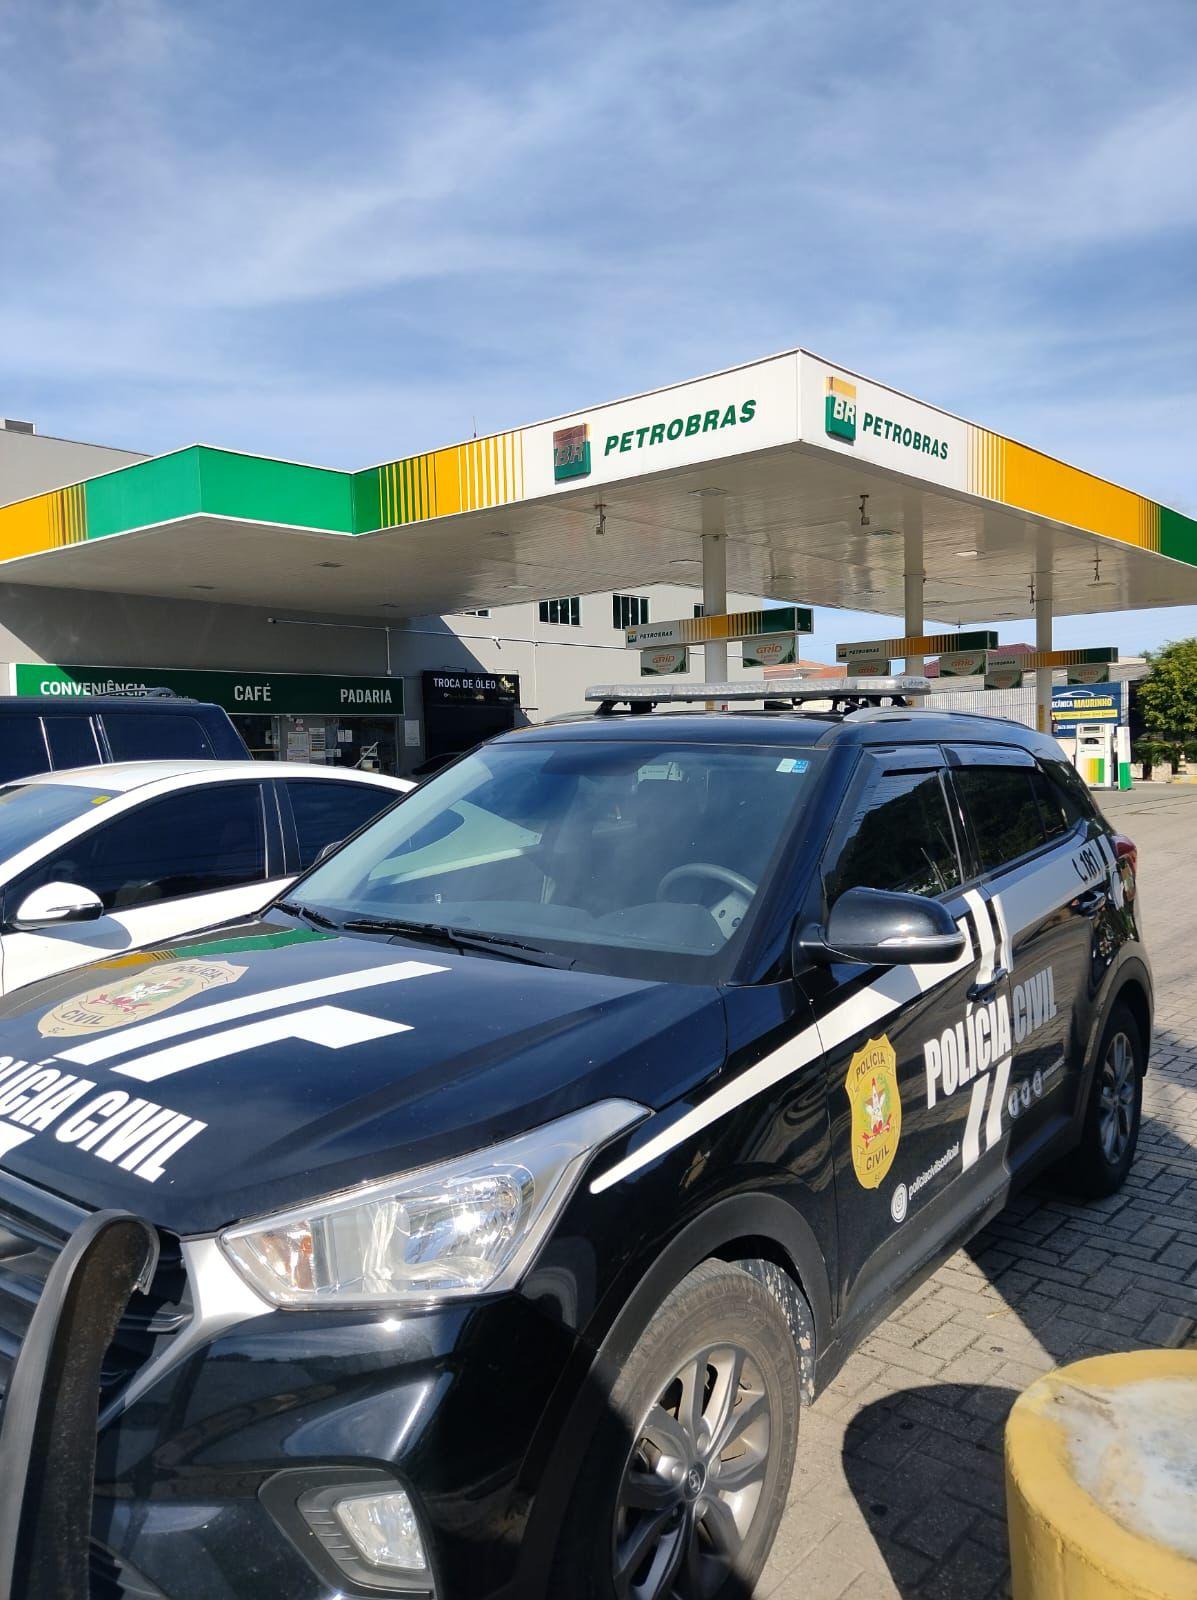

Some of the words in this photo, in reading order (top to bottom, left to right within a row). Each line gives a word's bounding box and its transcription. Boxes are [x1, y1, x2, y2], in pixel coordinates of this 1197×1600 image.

[832, 398, 856, 425] BR
[604, 399, 757, 457] PETROBRAS
[862, 412, 949, 460] PETROBRAS
[234, 682, 272, 702] CAFÉ
[340, 688, 393, 704] PADARIA
[433, 677, 461, 689] TROCA
[462, 679, 474, 689] DE
[475, 677, 496, 689] ÓLEO
[1052, 699, 1073, 709] ECÂNICA
[61, 1009, 105, 1026] CIVIL
[923, 993, 1012, 1109] POLÍCIA
[1012, 966, 1057, 1043] CIVIL
[855, 1051, 886, 1081] POLÍCIA
[55, 1090, 209, 1184] CIVIL
[866, 1146, 890, 1171] CIVIL
